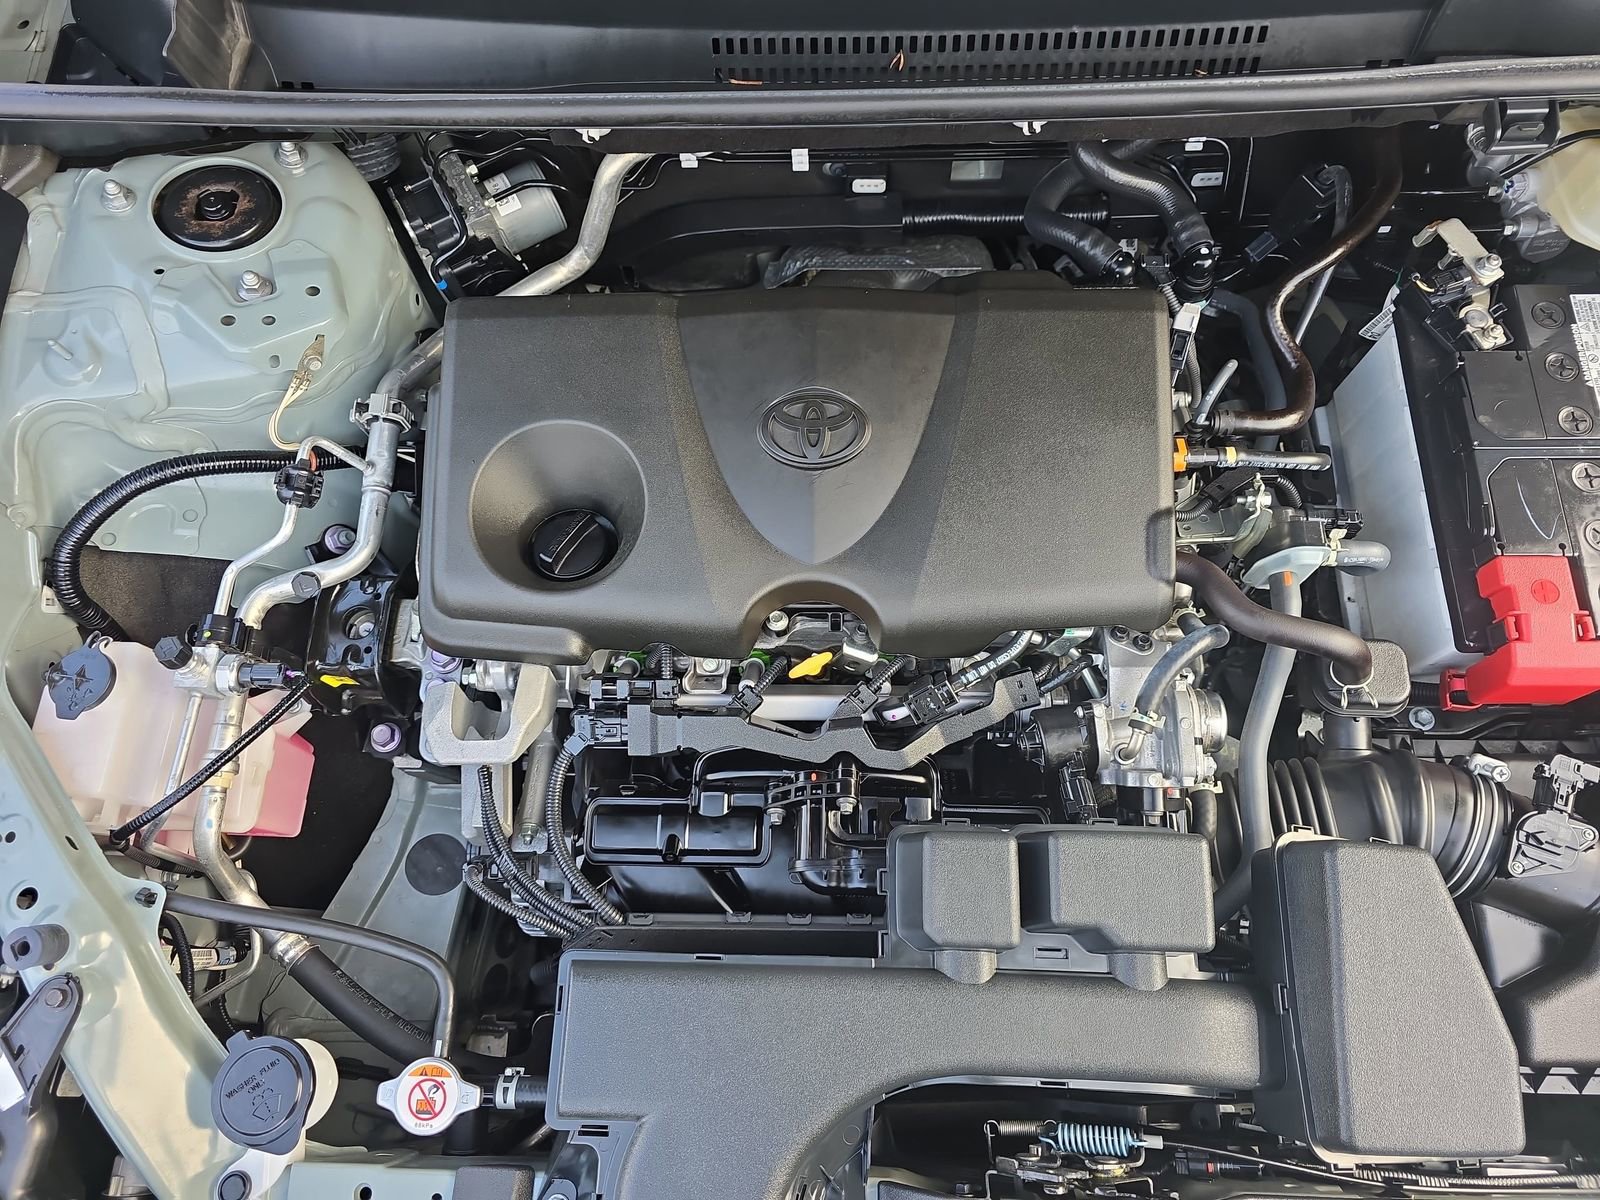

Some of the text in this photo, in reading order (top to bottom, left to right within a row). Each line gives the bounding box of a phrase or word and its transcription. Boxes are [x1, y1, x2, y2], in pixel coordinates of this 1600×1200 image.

[225, 1058, 281, 1099] WASHER FLUID
[247, 1079, 265, 1094] ONLY
